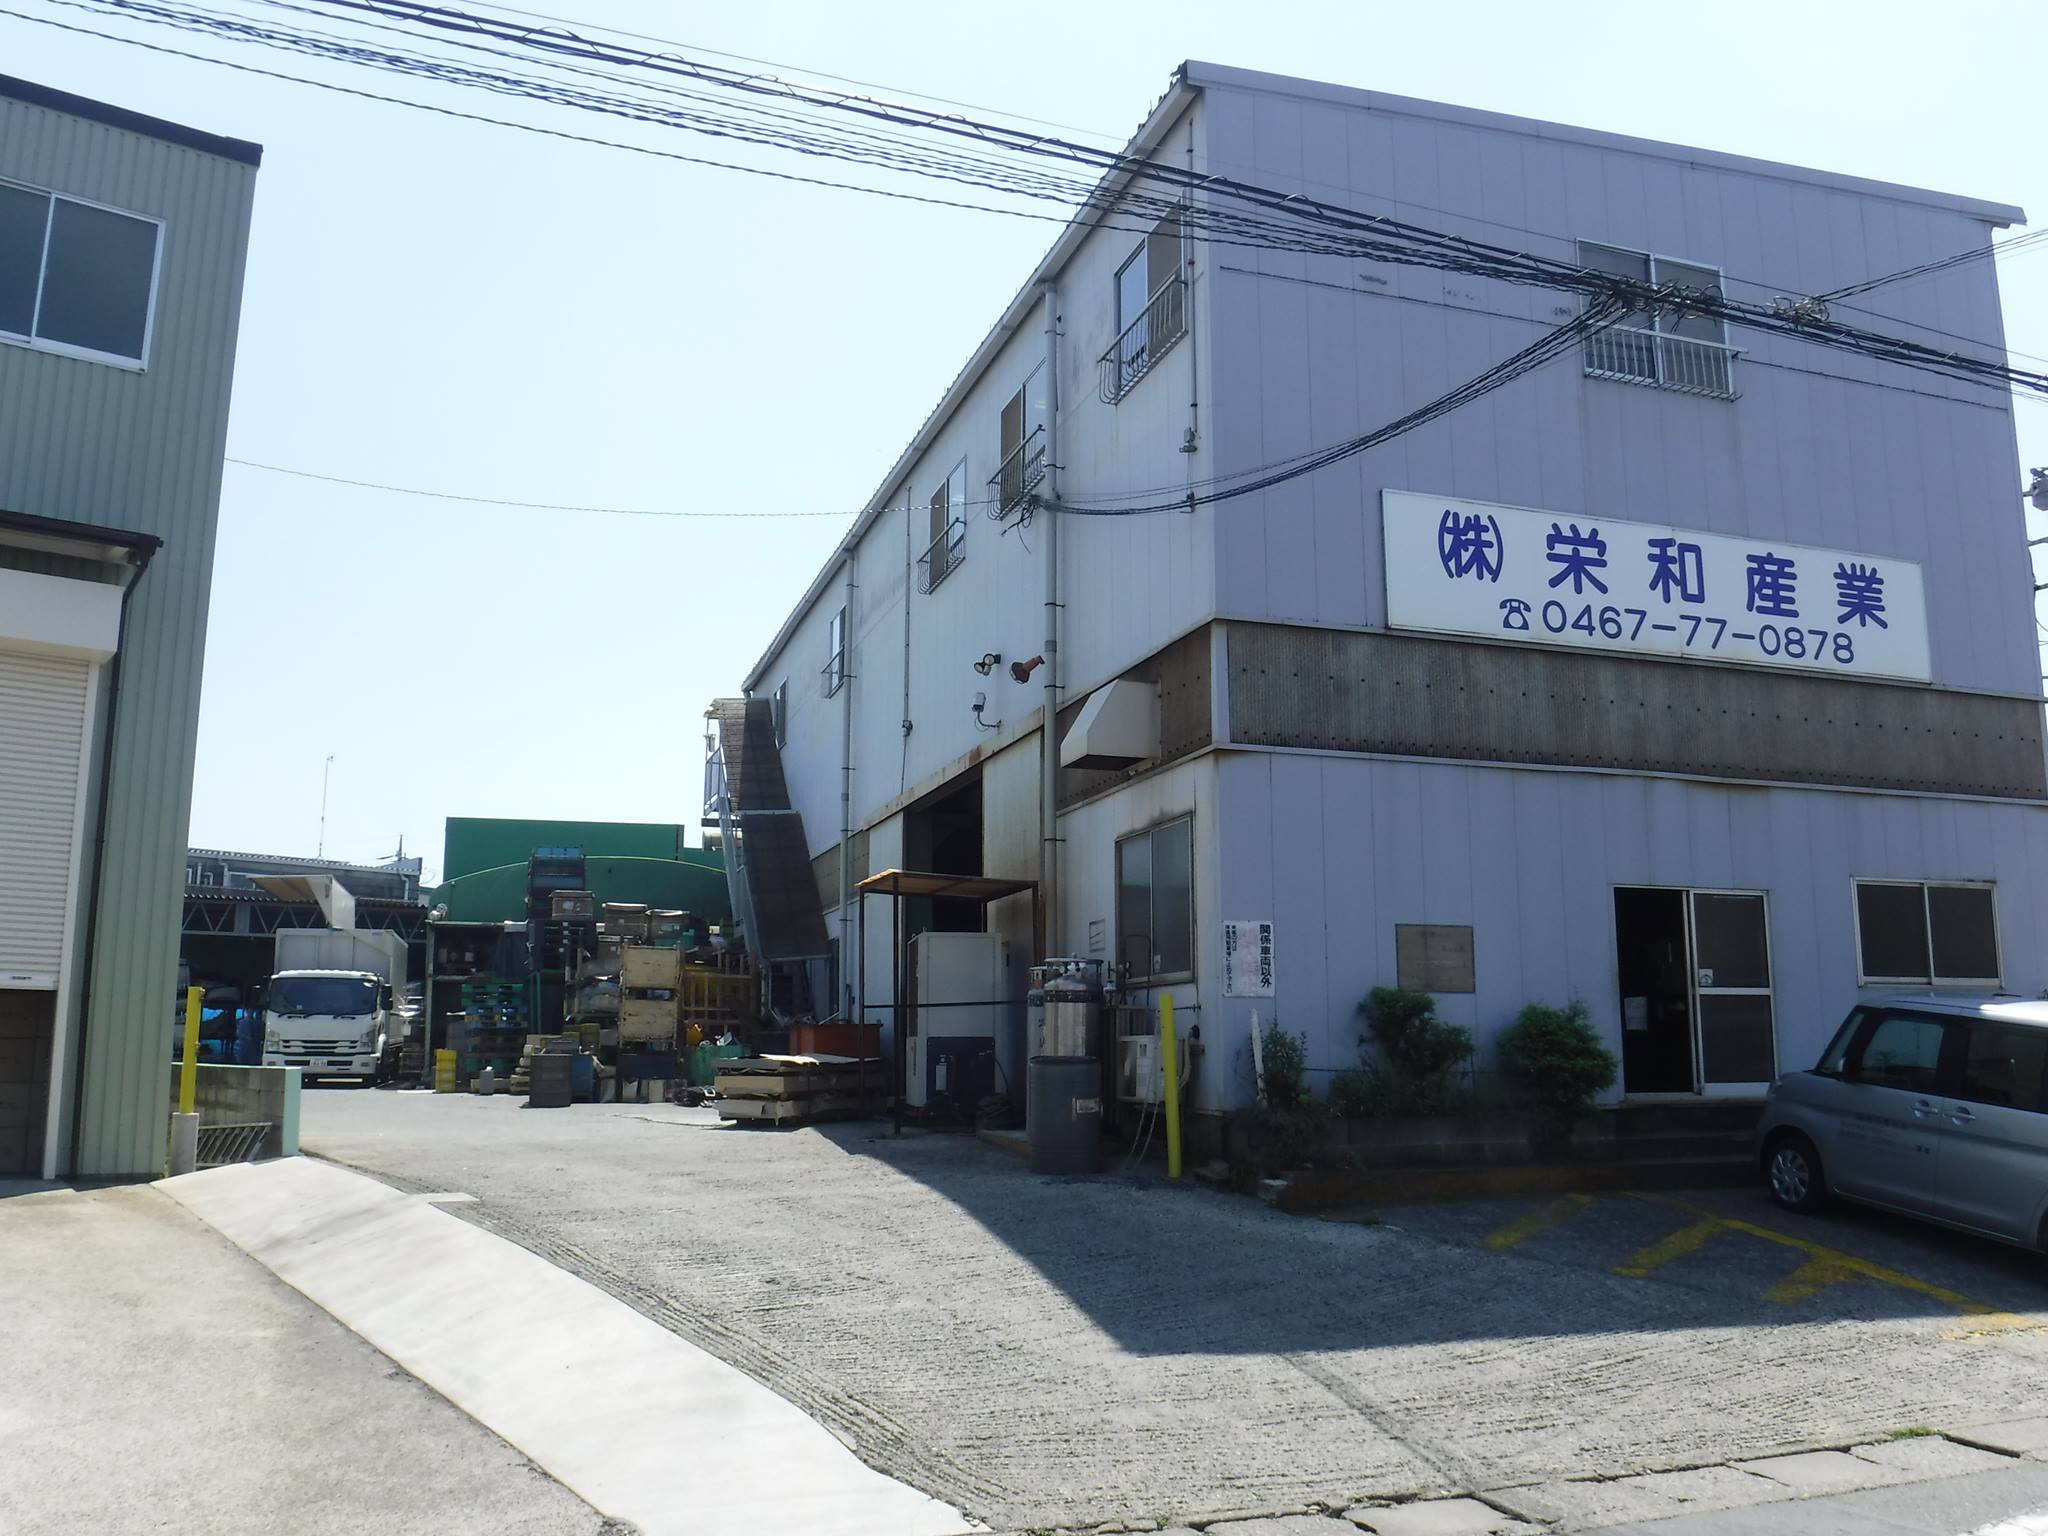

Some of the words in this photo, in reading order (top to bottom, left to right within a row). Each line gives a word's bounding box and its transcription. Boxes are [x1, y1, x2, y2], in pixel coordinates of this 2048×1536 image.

[1542, 600, 1855, 664] 0467-77-0878
[1259, 924, 1272, 989] 関係車両以外
